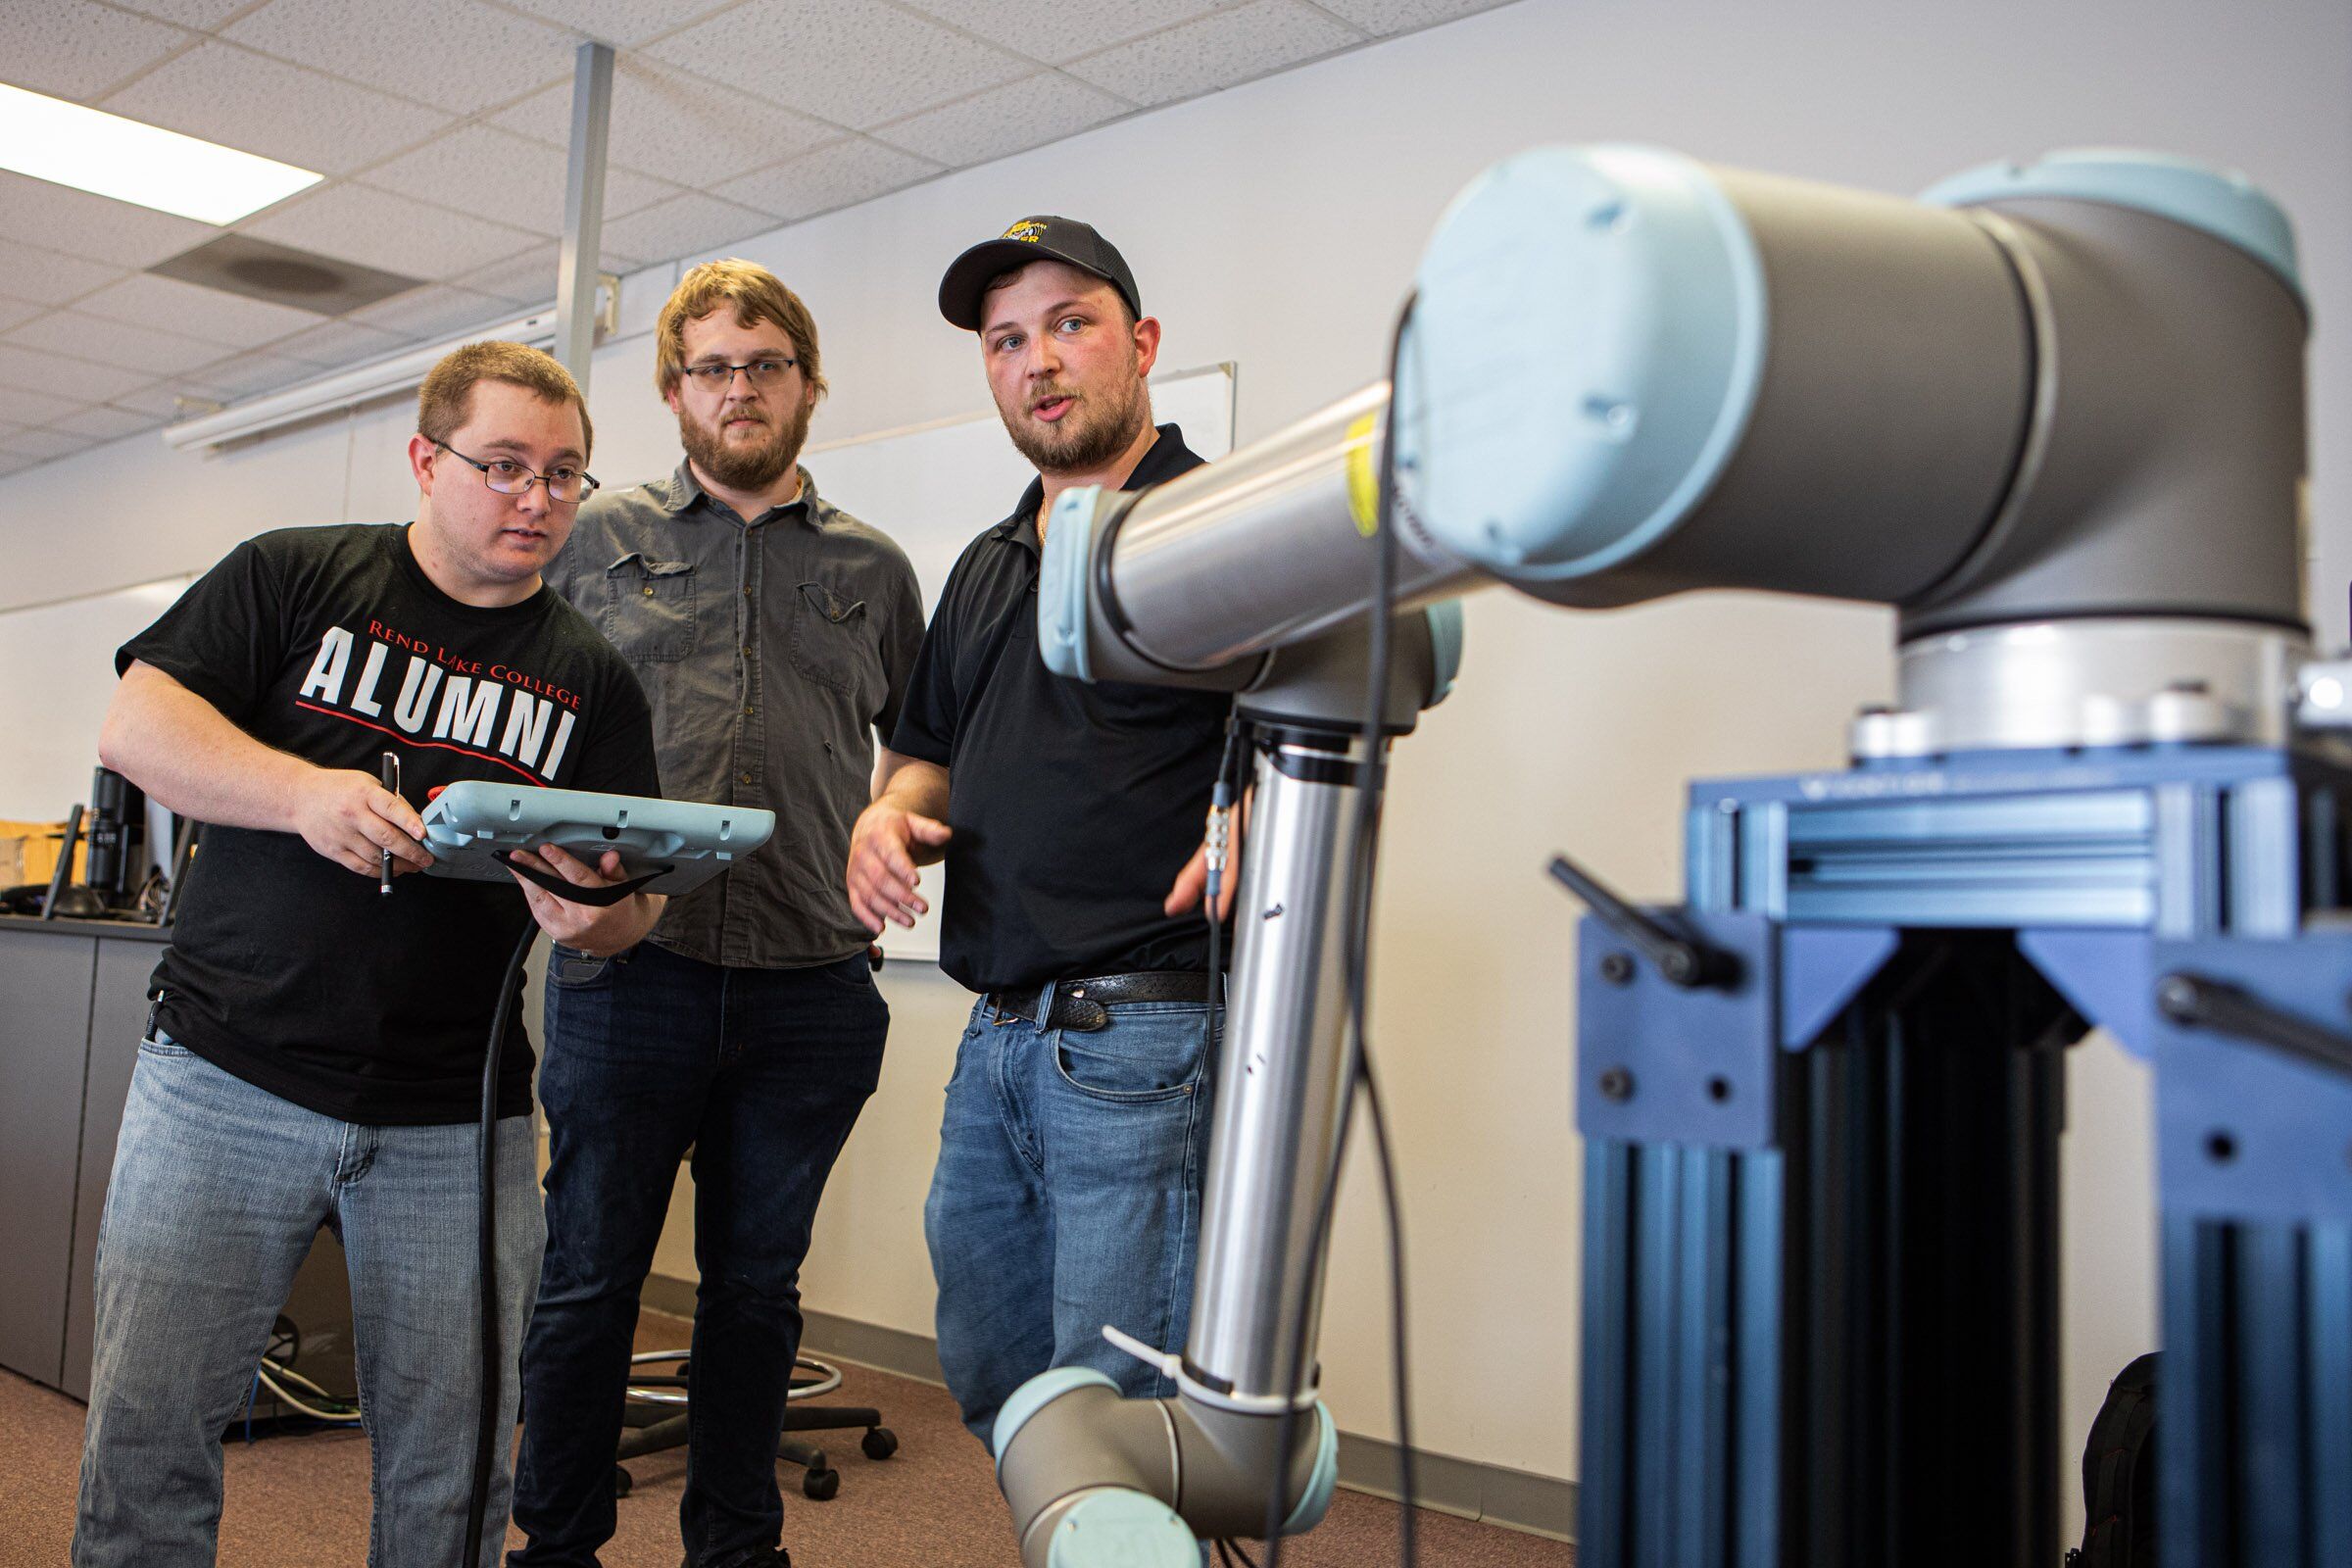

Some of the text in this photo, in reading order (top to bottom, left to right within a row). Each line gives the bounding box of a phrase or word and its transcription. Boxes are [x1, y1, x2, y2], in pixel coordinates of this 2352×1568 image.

[299, 626, 576, 780] ALUMNI
[368, 619, 581, 710] REND LAKE COLLEGE
